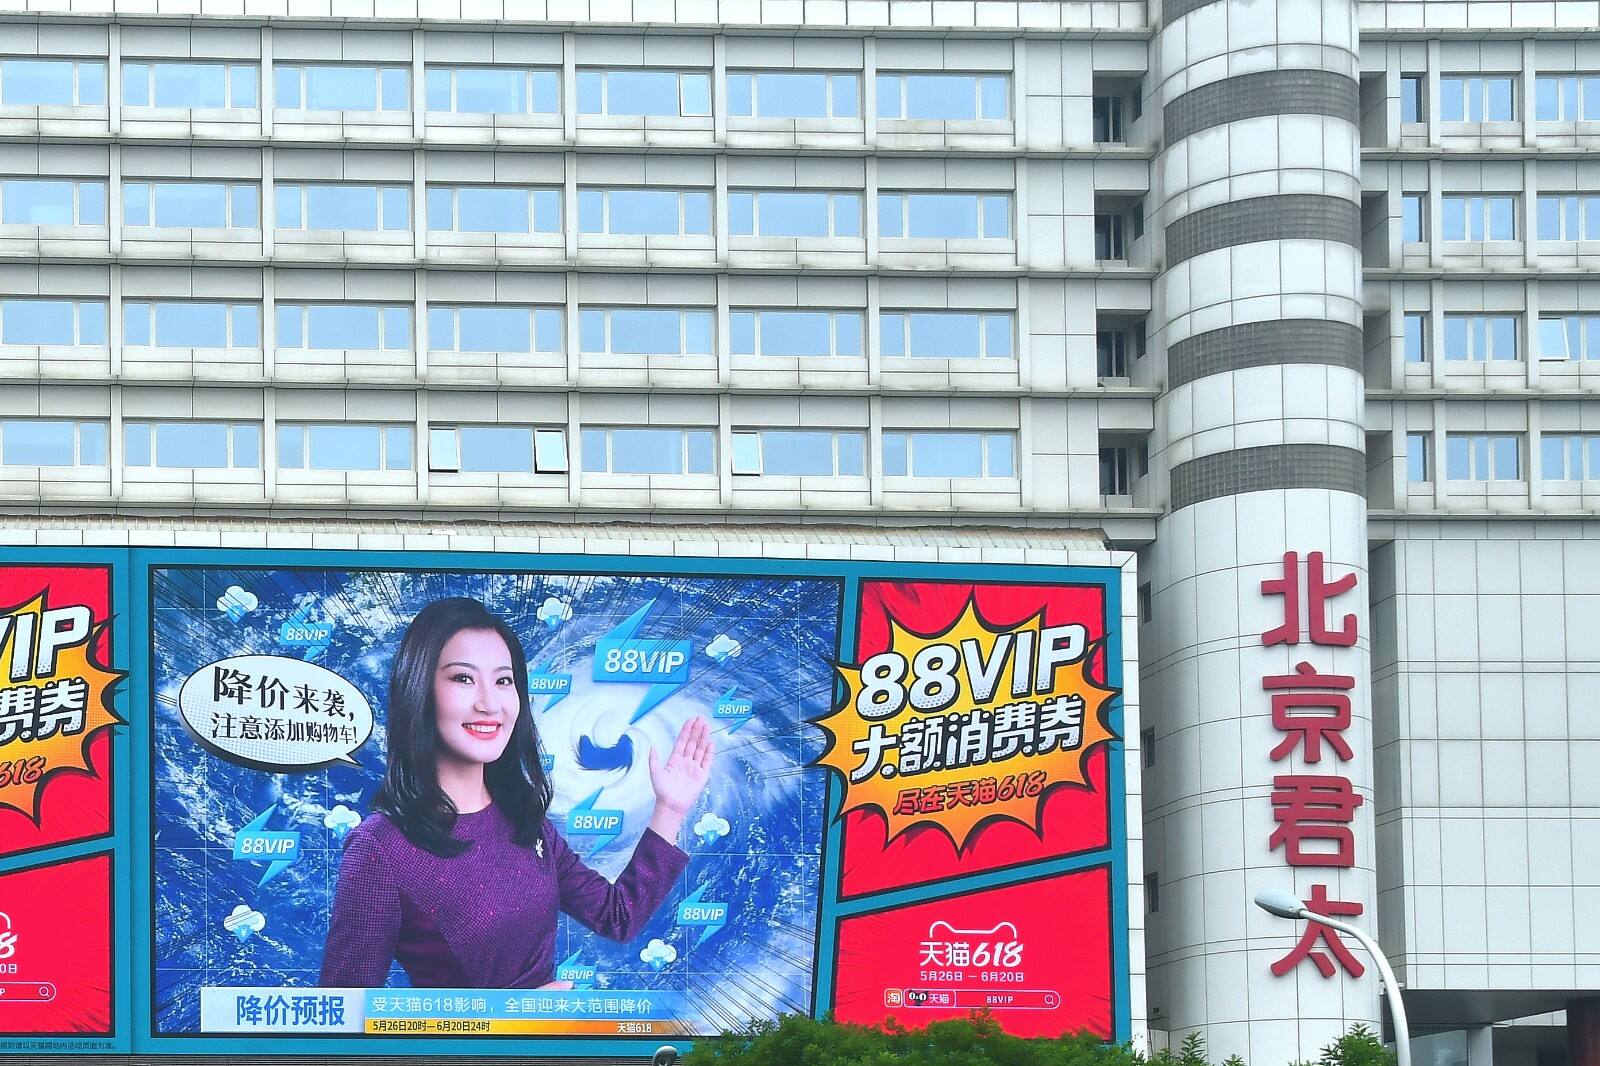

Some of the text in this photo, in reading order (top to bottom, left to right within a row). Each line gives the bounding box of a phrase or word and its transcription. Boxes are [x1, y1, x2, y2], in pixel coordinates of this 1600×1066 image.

[286, 626, 328, 642] 88VIP
[604, 648, 684, 673] 88VIP
[855, 623, 1087, 719] 88VIP
[531, 678, 568, 691] 88VIP
[717, 704, 750, 715] 88VIP
[850, 694, 1085, 783] 大额消费券
[1260, 551, 1366, 979] 北京君太
[892, 771, 1048, 816] 尽在天猫618
[573, 814, 619, 831] 88VIP
[241, 837, 295, 855] 88VIP
[683, 906, 724, 922] 88VIP
[919, 940, 1024, 967] 天猫618
[560, 969, 594, 981] 88VIP
[920, 971, 963, 982] 5月26日
[981, 971, 1025, 982] 6月20日
[887, 992, 950, 1004] 淘 天猫
[986, 995, 1014, 1004] 88VIP
[236, 995, 346, 1027] 降价预报
[617, 1022, 652, 1034] 天猫618
